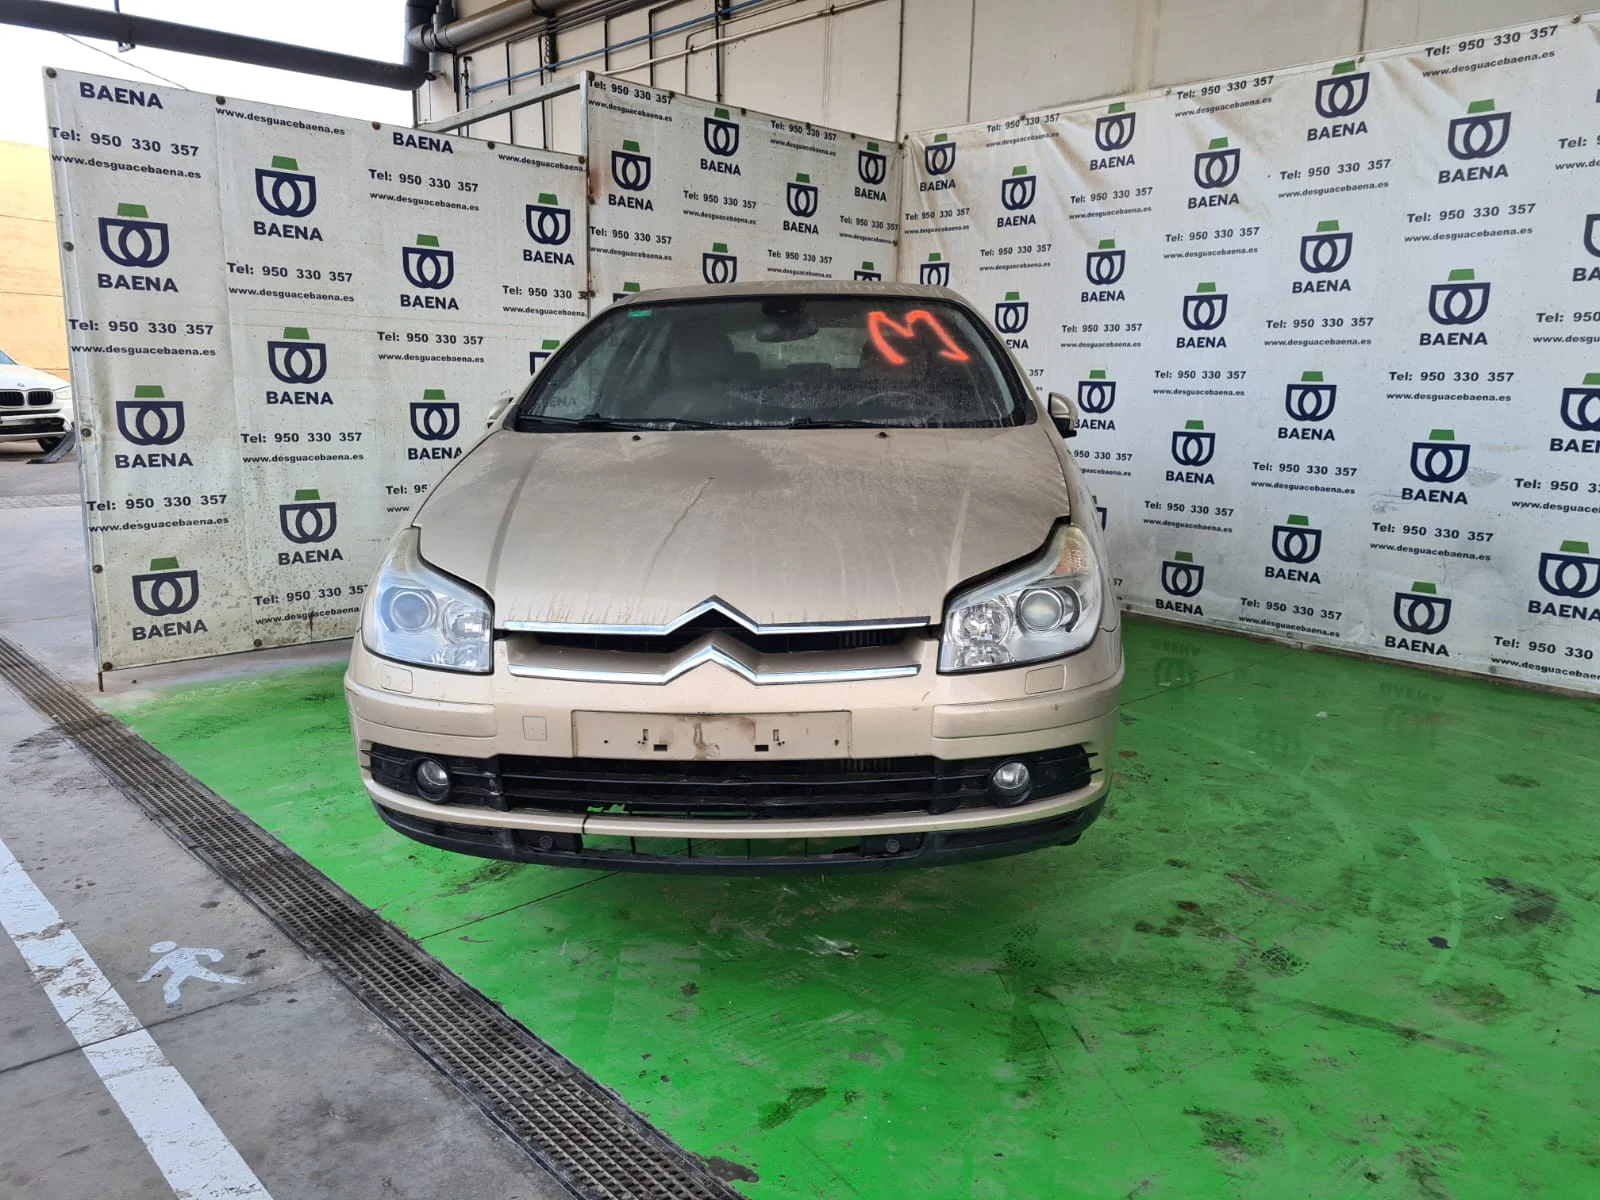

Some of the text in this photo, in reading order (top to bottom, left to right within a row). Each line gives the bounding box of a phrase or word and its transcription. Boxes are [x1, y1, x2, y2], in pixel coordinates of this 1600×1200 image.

[1425, 25, 1558, 57] Tel: 950 330 357
[1422, 50, 1555, 78] www.desguacebaena.es
[80, 82, 163, 109] BAENA
[611, 83, 630, 95] 950
[634, 88, 651, 100] 330
[656, 93, 673, 104] 357
[1177, 75, 1274, 100] Tel: 950 330 357
[1175, 97, 1272, 118] www.desguacebaena.es
[216, 107, 345, 135] www.desguacebaena.es
[1307, 121, 1368, 141] BAENA
[49, 126, 198, 156] Tel: 950 330 357
[393, 131, 454, 154] BAENA
[52, 154, 201, 178] www.desguacebaena.es
[701, 158, 741, 176] BAENA
[1090, 154, 1135, 171] BAENA
[1280, 159, 1391, 180] Tel: 950 330 357
[368, 169, 478, 192] Tel: 950 330 357
[1438, 164, 1508, 184] BAENA
[920, 179, 956, 191] BAENA
[1278, 182, 1389, 199] www.desguacebaena.es
[370, 192, 479, 212] www.desguacebaena.es
[609, 194, 653, 211] BAENA
[855, 187, 887, 202] BAENA
[1188, 193, 1239, 209] BAENA
[997, 214, 1036, 228] BAENA
[1407, 203, 1536, 223] Tel: 950 330 357
[254, 221, 323, 241] BAENA
[783, 220, 818, 235] BAENA
[1165, 227, 1260, 242] Tel: 950 330 357
[1404, 227, 1533, 242] www.desguacebaena.es
[523, 249, 575, 265] BAENA
[1163, 246, 1258, 259] www.desguacebaena.es
[227, 262, 352, 282] Tel: 950 330 357
[98, 273, 178, 292] BAENA
[1292, 279, 1351, 293] BAENA
[229, 286, 354, 302] www.desguacebaena.es
[502, 285, 522, 295] Tel:
[528, 288, 547, 297] 950
[554, 289, 572, 299] 330
[1081, 290, 1125, 302] BAENA
[400, 294, 459, 310] BAENA
[1266, 317, 1374, 328] Tel: 950 330 357
[1536, 312, 1600, 322] Tel: 950
[69, 319, 213, 335] Tel: 950 330 357
[1082, 324, 1098, 332] 950
[1104, 324, 1120, 332] 330
[1126, 323, 1142, 331] 357
[377, 331, 483, 345] Tel: 950 330 357
[1177, 337, 1226, 348] BAENA
[1264, 338, 1371, 347] www.desguacebaena.es
[1419, 332, 1487, 345] BAENA
[71, 344, 216, 356] www.desguacebaena.es
[378, 353, 484, 364] www.desguacebaena.es
[1178, 371, 1196, 379] 950
[1202, 371, 1220, 379] 330
[1227, 371, 1246, 379] 357
[1389, 372, 1514, 381] Tel: 950 330 357
[266, 391, 333, 404] BAENA
[1386, 391, 1511, 402] www.desguacebaena.es
[240, 432, 362, 443] Tel: 950 330 357
[1278, 427, 1335, 441] BAENA
[115, 453, 193, 468] BAENA
[242, 453, 363, 464] www.desguacebaena.es
[408, 447, 463, 461] BAENA
[1074, 450, 1089, 458] 950
[1116, 453, 1132, 461] 357
[1253, 462, 1357, 476] Tel: 950 330 357
[1166, 471, 1214, 484] BAENA
[1515, 478, 1541, 489] Tel:
[1551, 481, 1578, 491] 950
[1251, 480, 1355, 495] www.desguacebaena.es
[86, 494, 227, 511] Tel: 950 330 357
[1402, 488, 1468, 504] BAENA
[89, 516, 229, 533] www.desguacebaena.es
[1372, 522, 1493, 542] Tel: 950 330 357
[278, 548, 343, 565] BAENA
[1370, 542, 1491, 561] www.desguacebaena.es
[1265, 566, 1320, 584] BAENA
[254, 595, 279, 605] Tel:
[287, 591, 310, 601] 950
[319, 587, 341, 598] 330
[1154, 597, 1203, 617] BAENA
[1240, 598, 1342, 620] Tel: 950 330 357
[1528, 600, 1600, 621] BAENA
[132, 619, 208, 640] BAENA
[1239, 615, 1340, 638] www.desguacebaena.es
[1384, 634, 1449, 658] BAENA
[1494, 636, 1593, 659] Tel: 950 330
